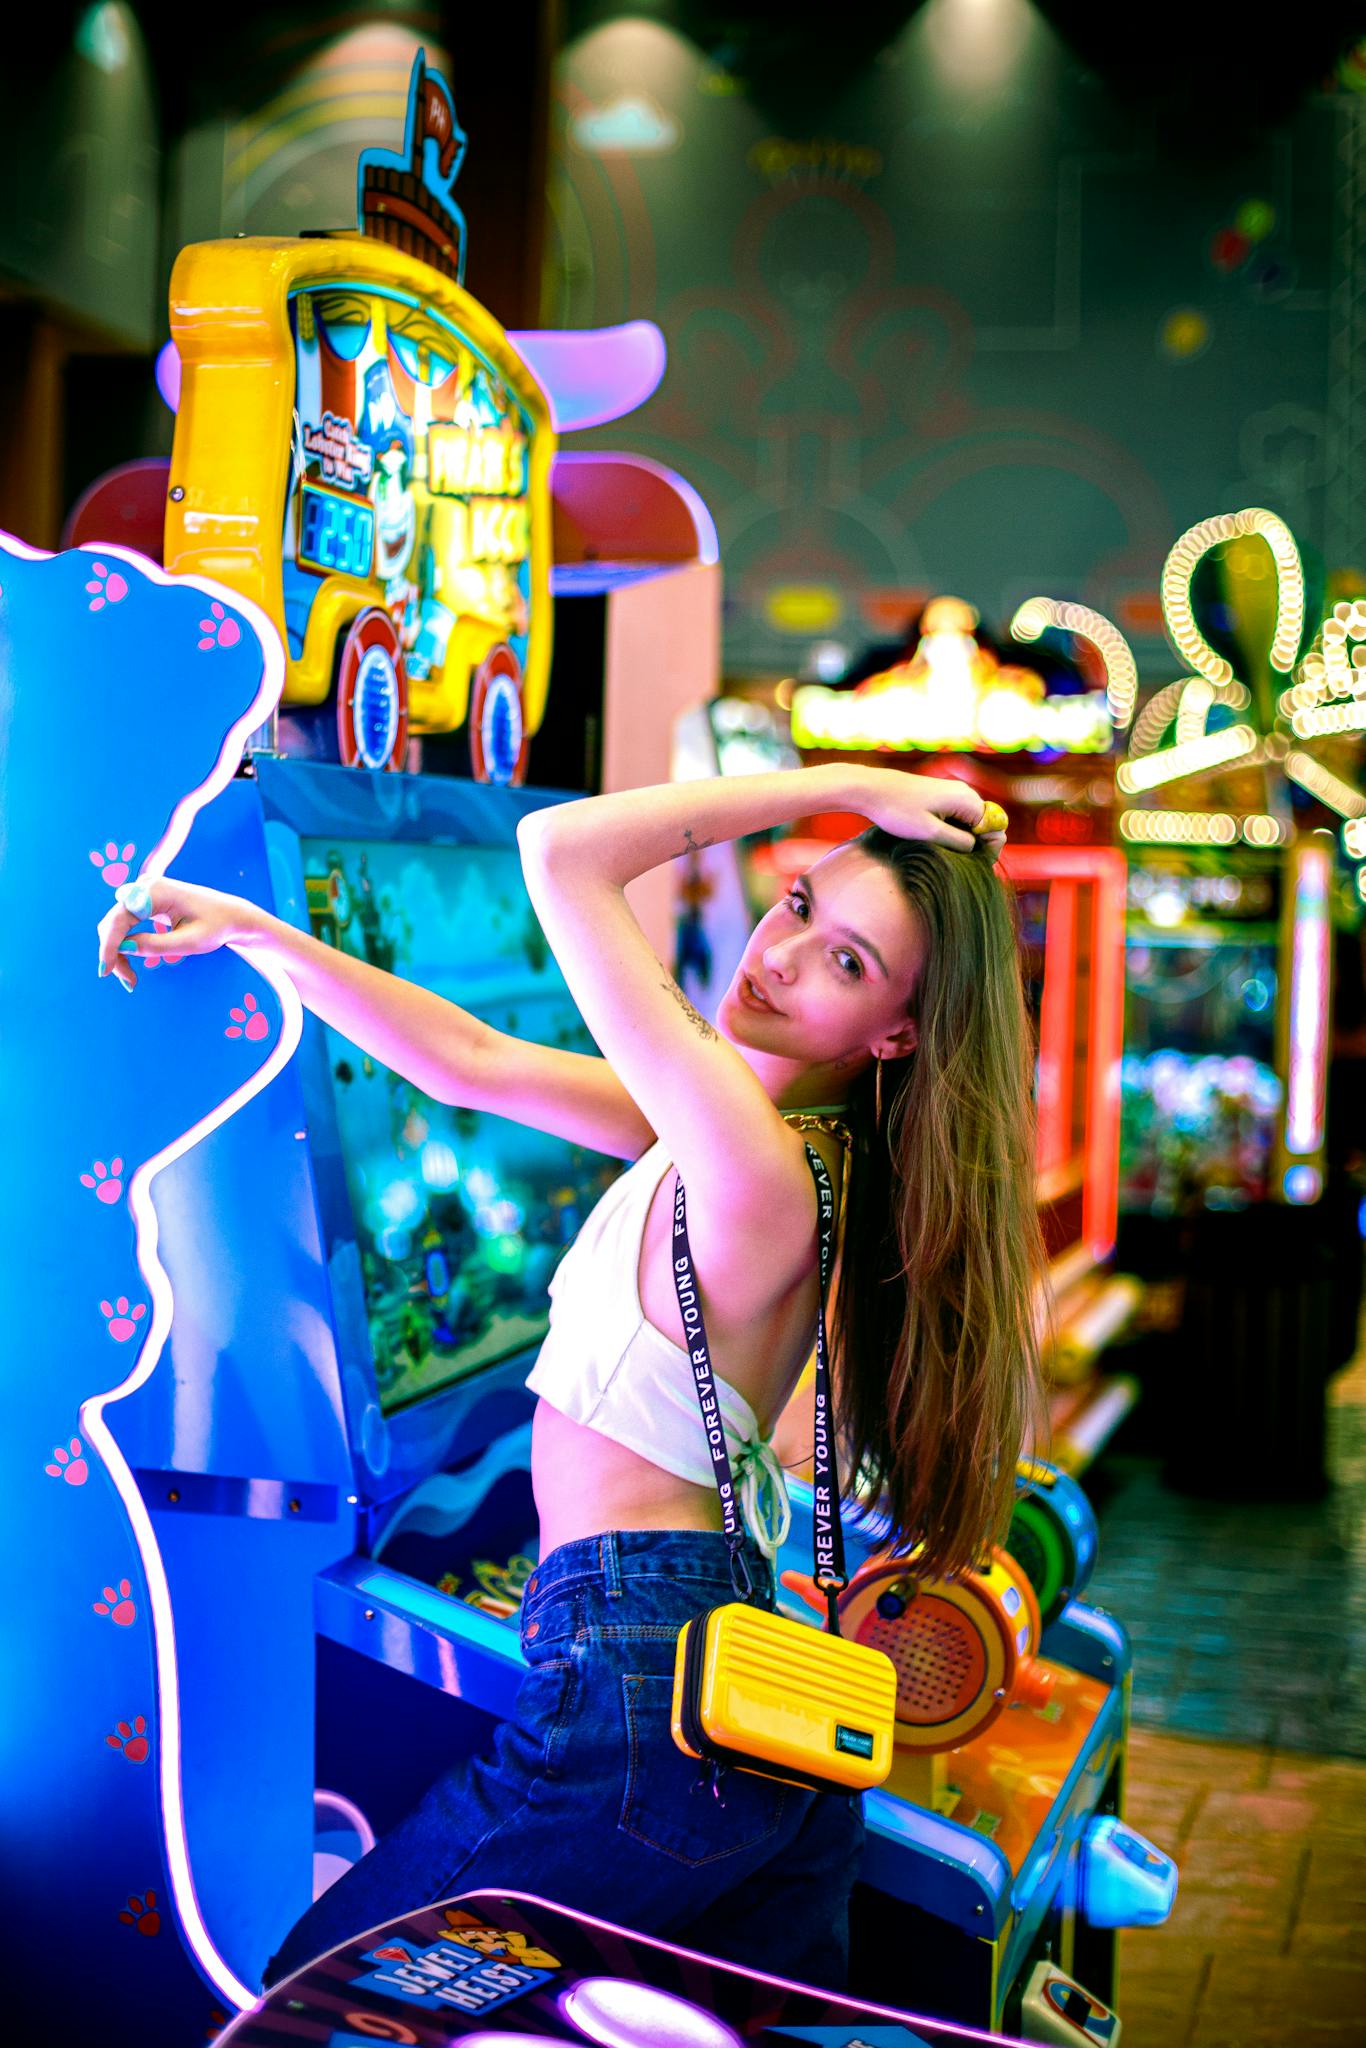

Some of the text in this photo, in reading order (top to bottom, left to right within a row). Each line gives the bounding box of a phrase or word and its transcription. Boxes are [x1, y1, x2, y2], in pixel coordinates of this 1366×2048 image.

[320, 500, 373, 576] 250
[675, 1256, 701, 1340] YOUNG
[692, 1347, 725, 1461] FOREVER
[815, 1394, 829, 1480] YOUNG
[374, 1947, 483, 1995] JEWEL
[434, 1963, 534, 2009] HEIST
